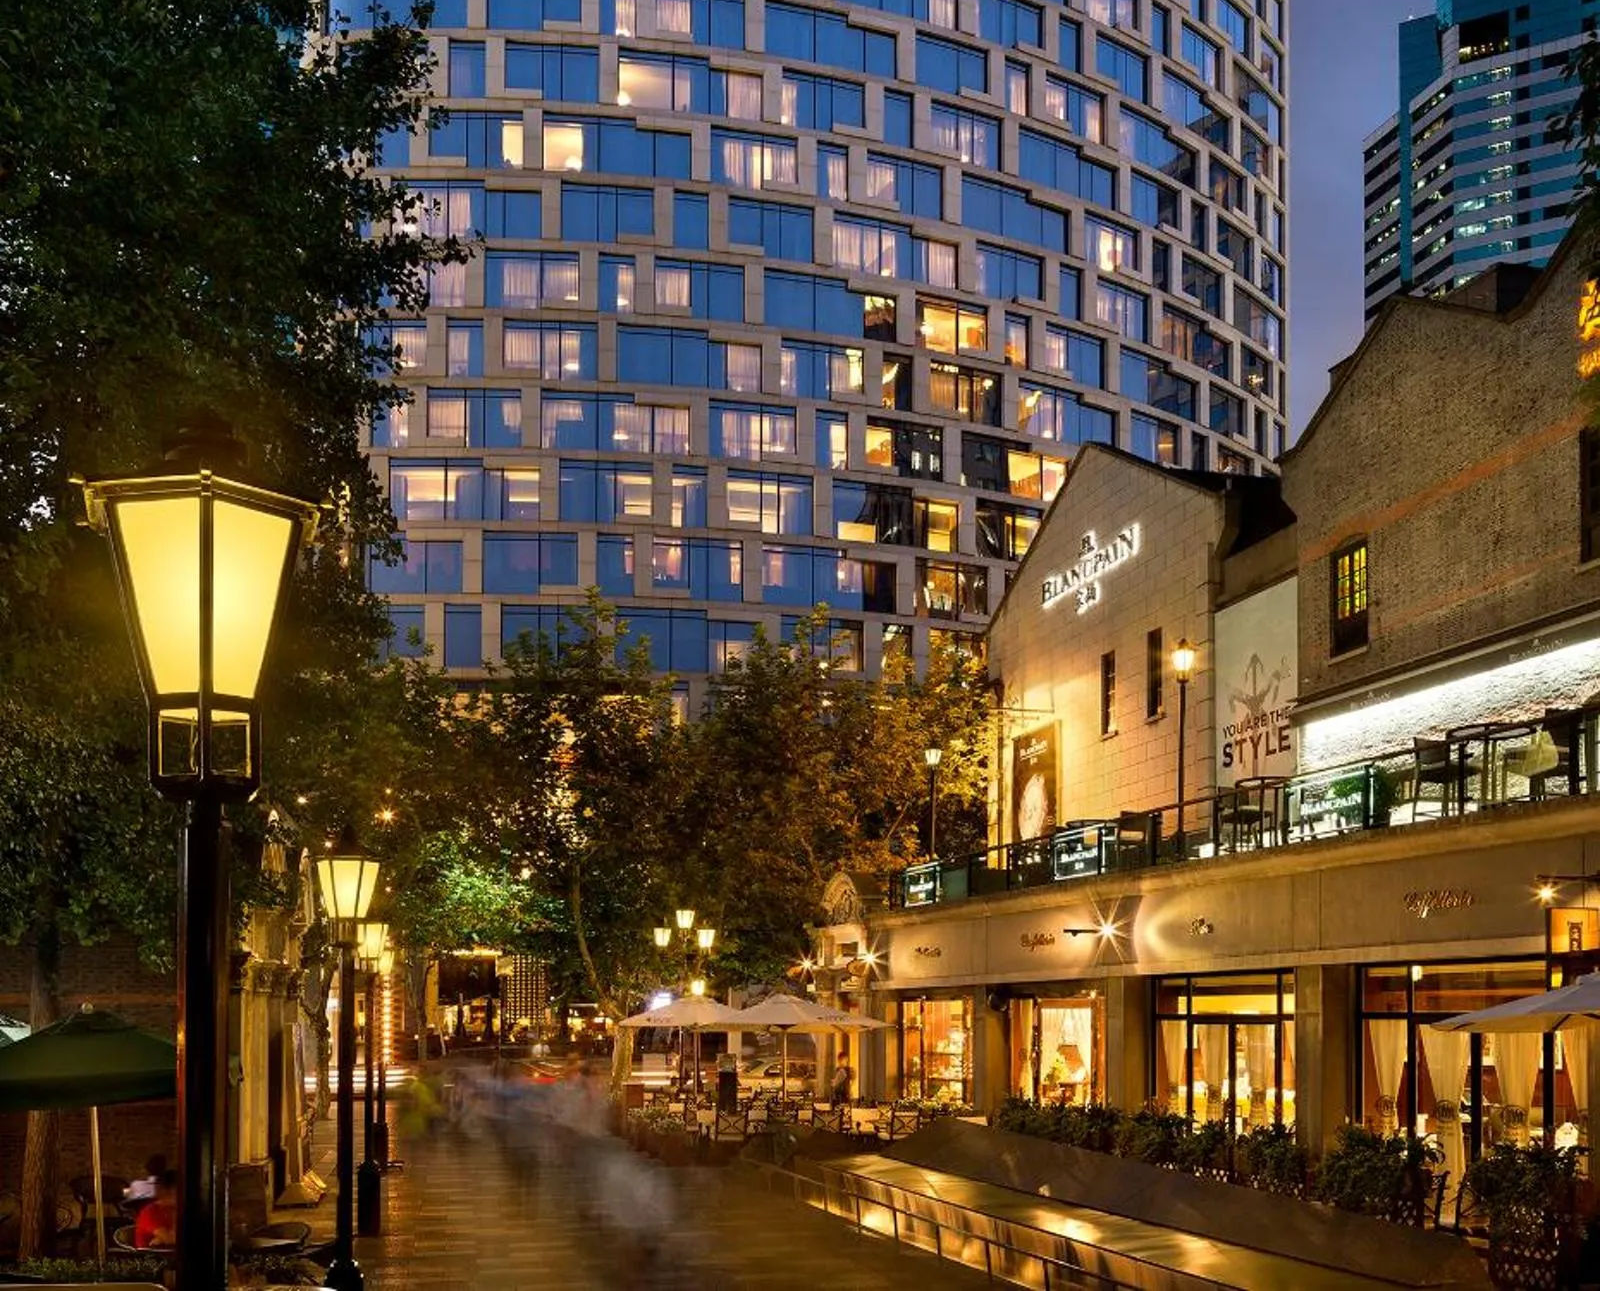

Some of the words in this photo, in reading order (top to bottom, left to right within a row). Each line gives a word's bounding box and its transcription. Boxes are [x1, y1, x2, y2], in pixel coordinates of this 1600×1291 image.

[1041, 522, 1141, 608] BLANCPAIN
[1222, 721, 1243, 739] YOU
[1244, 712, 1267, 732] ARE
[1222, 724, 1291, 768] STYLE
